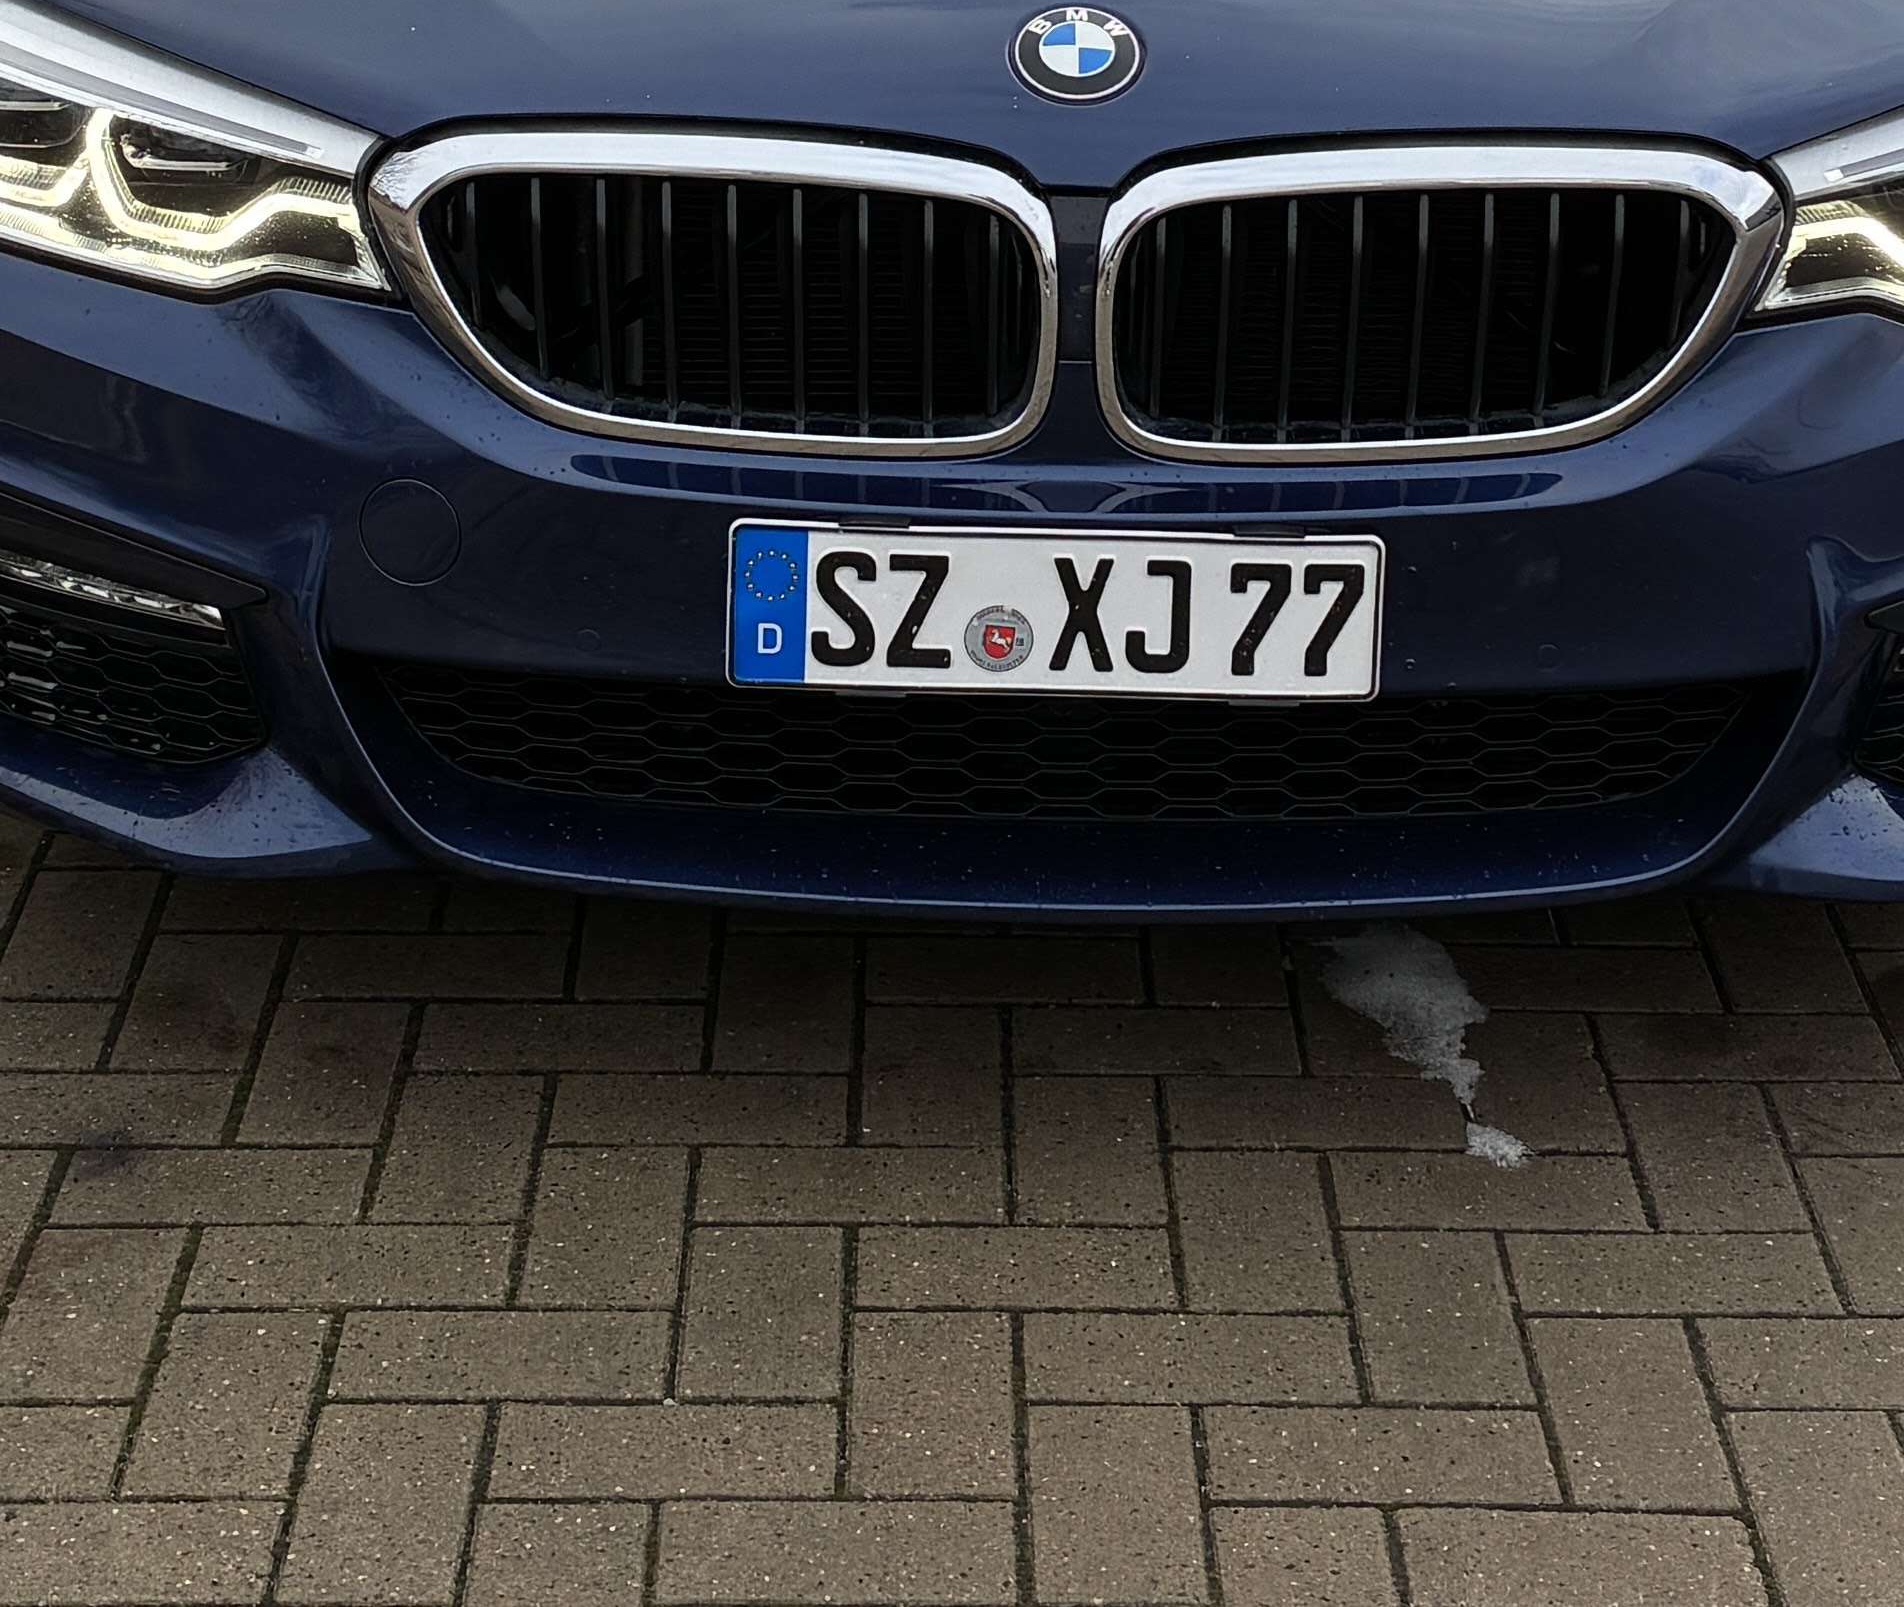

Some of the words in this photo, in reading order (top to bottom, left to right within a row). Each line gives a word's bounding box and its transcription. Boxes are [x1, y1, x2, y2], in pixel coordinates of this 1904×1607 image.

[1028, 9, 1129, 37] BMW
[756, 622, 783, 655] D
[809, 549, 953, 670] SZ
[1048, 556, 1195, 675] XJ
[1228, 561, 1367, 678] 77
